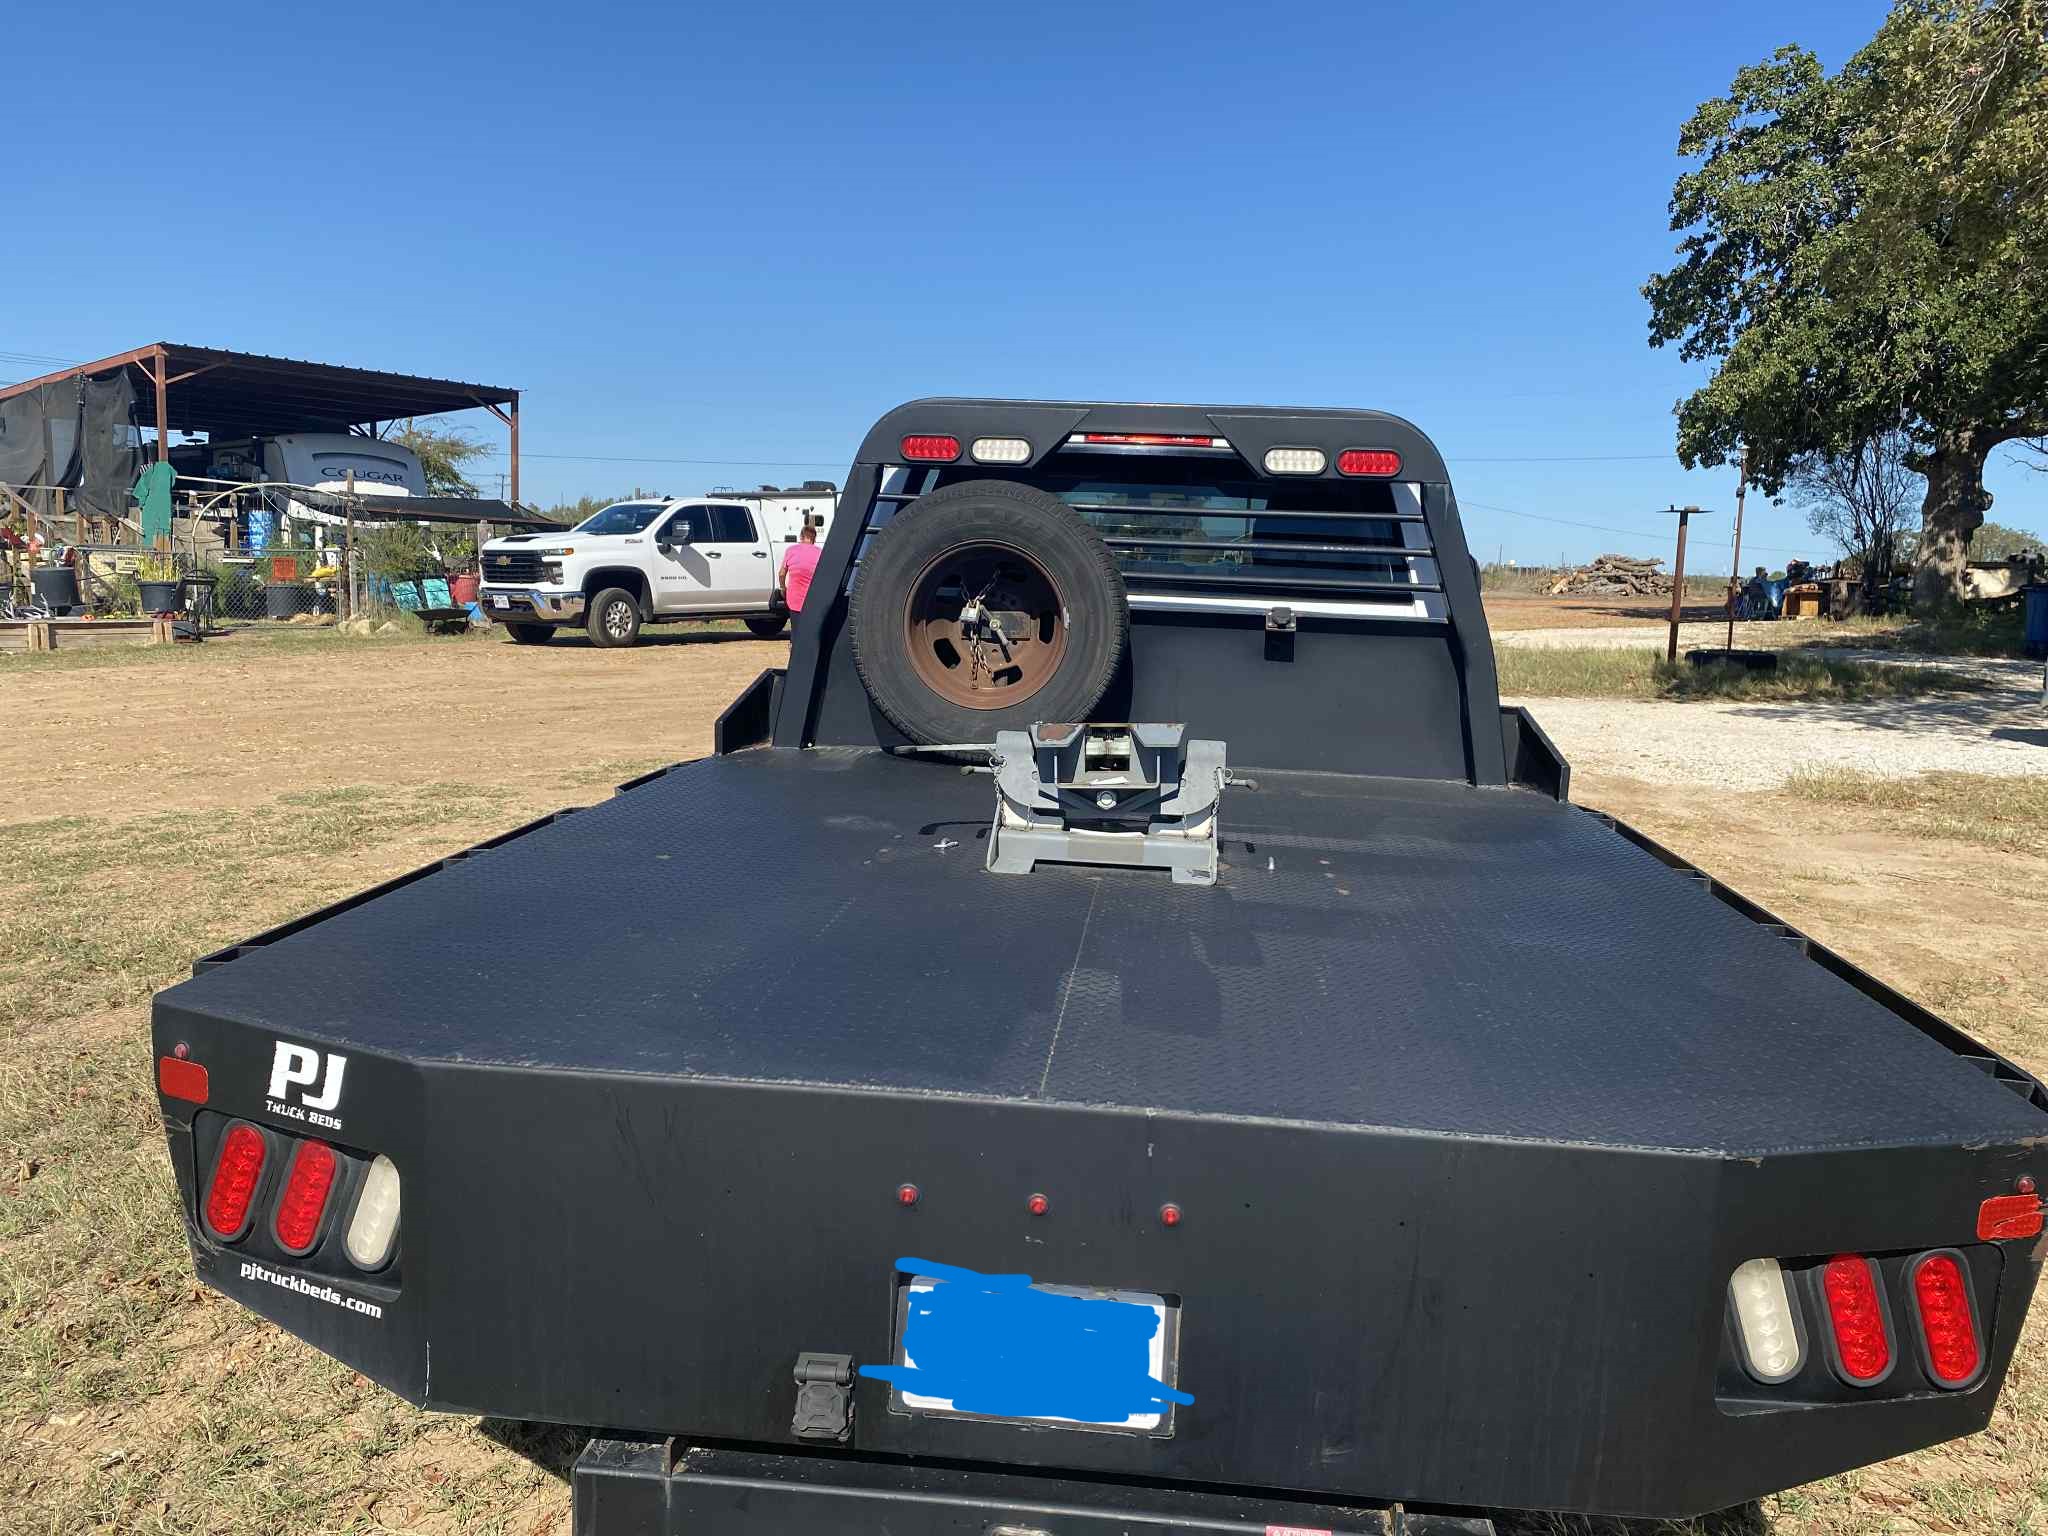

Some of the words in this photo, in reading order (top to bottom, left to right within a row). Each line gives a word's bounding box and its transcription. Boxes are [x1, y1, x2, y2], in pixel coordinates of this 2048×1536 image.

[321, 467, 404, 482] COUGAR
[267, 1040, 347, 1111] PJ
[265, 1099, 305, 1121] TRUCK
[308, 1111, 342, 1130] BEDS
[240, 1261, 382, 1319] pjtruckbeds.com
